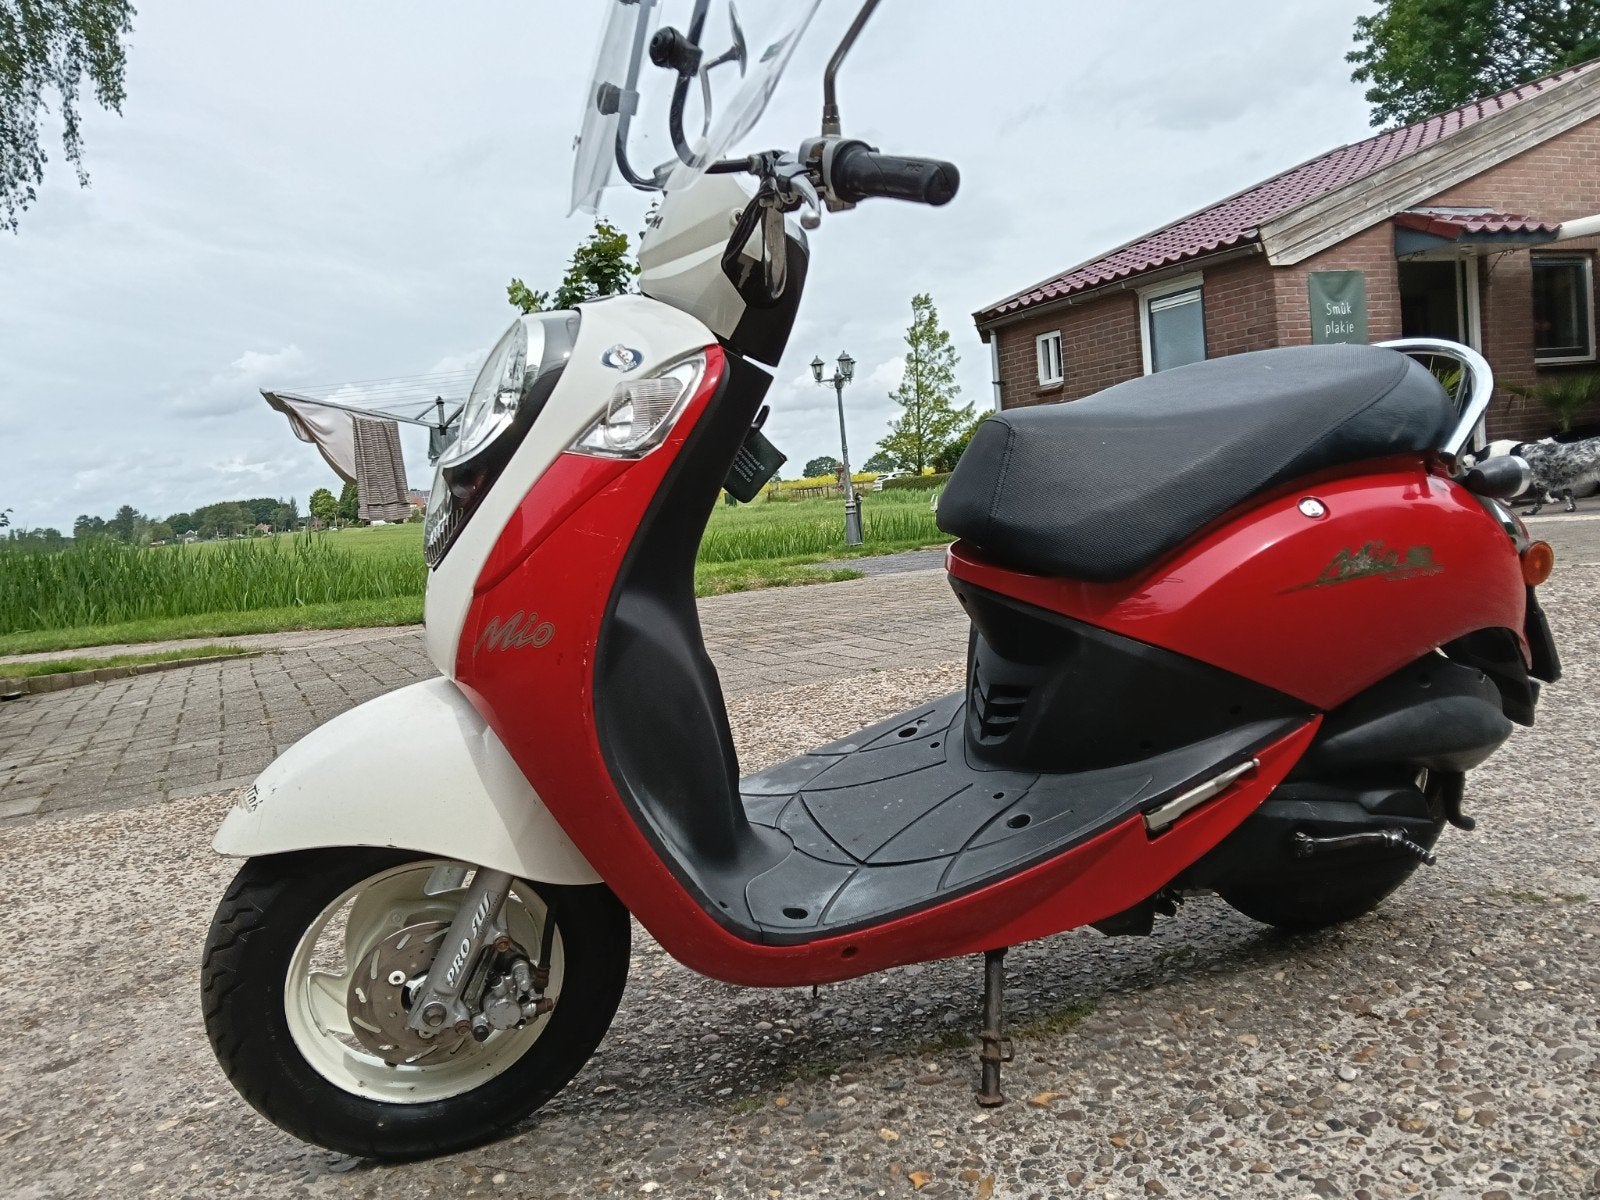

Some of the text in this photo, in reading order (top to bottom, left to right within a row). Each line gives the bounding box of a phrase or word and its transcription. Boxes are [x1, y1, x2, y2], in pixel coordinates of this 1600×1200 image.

[1326, 302, 1352, 316] Smûk
[472, 610, 555, 657] Mio
[447, 938, 470, 987] PRO
